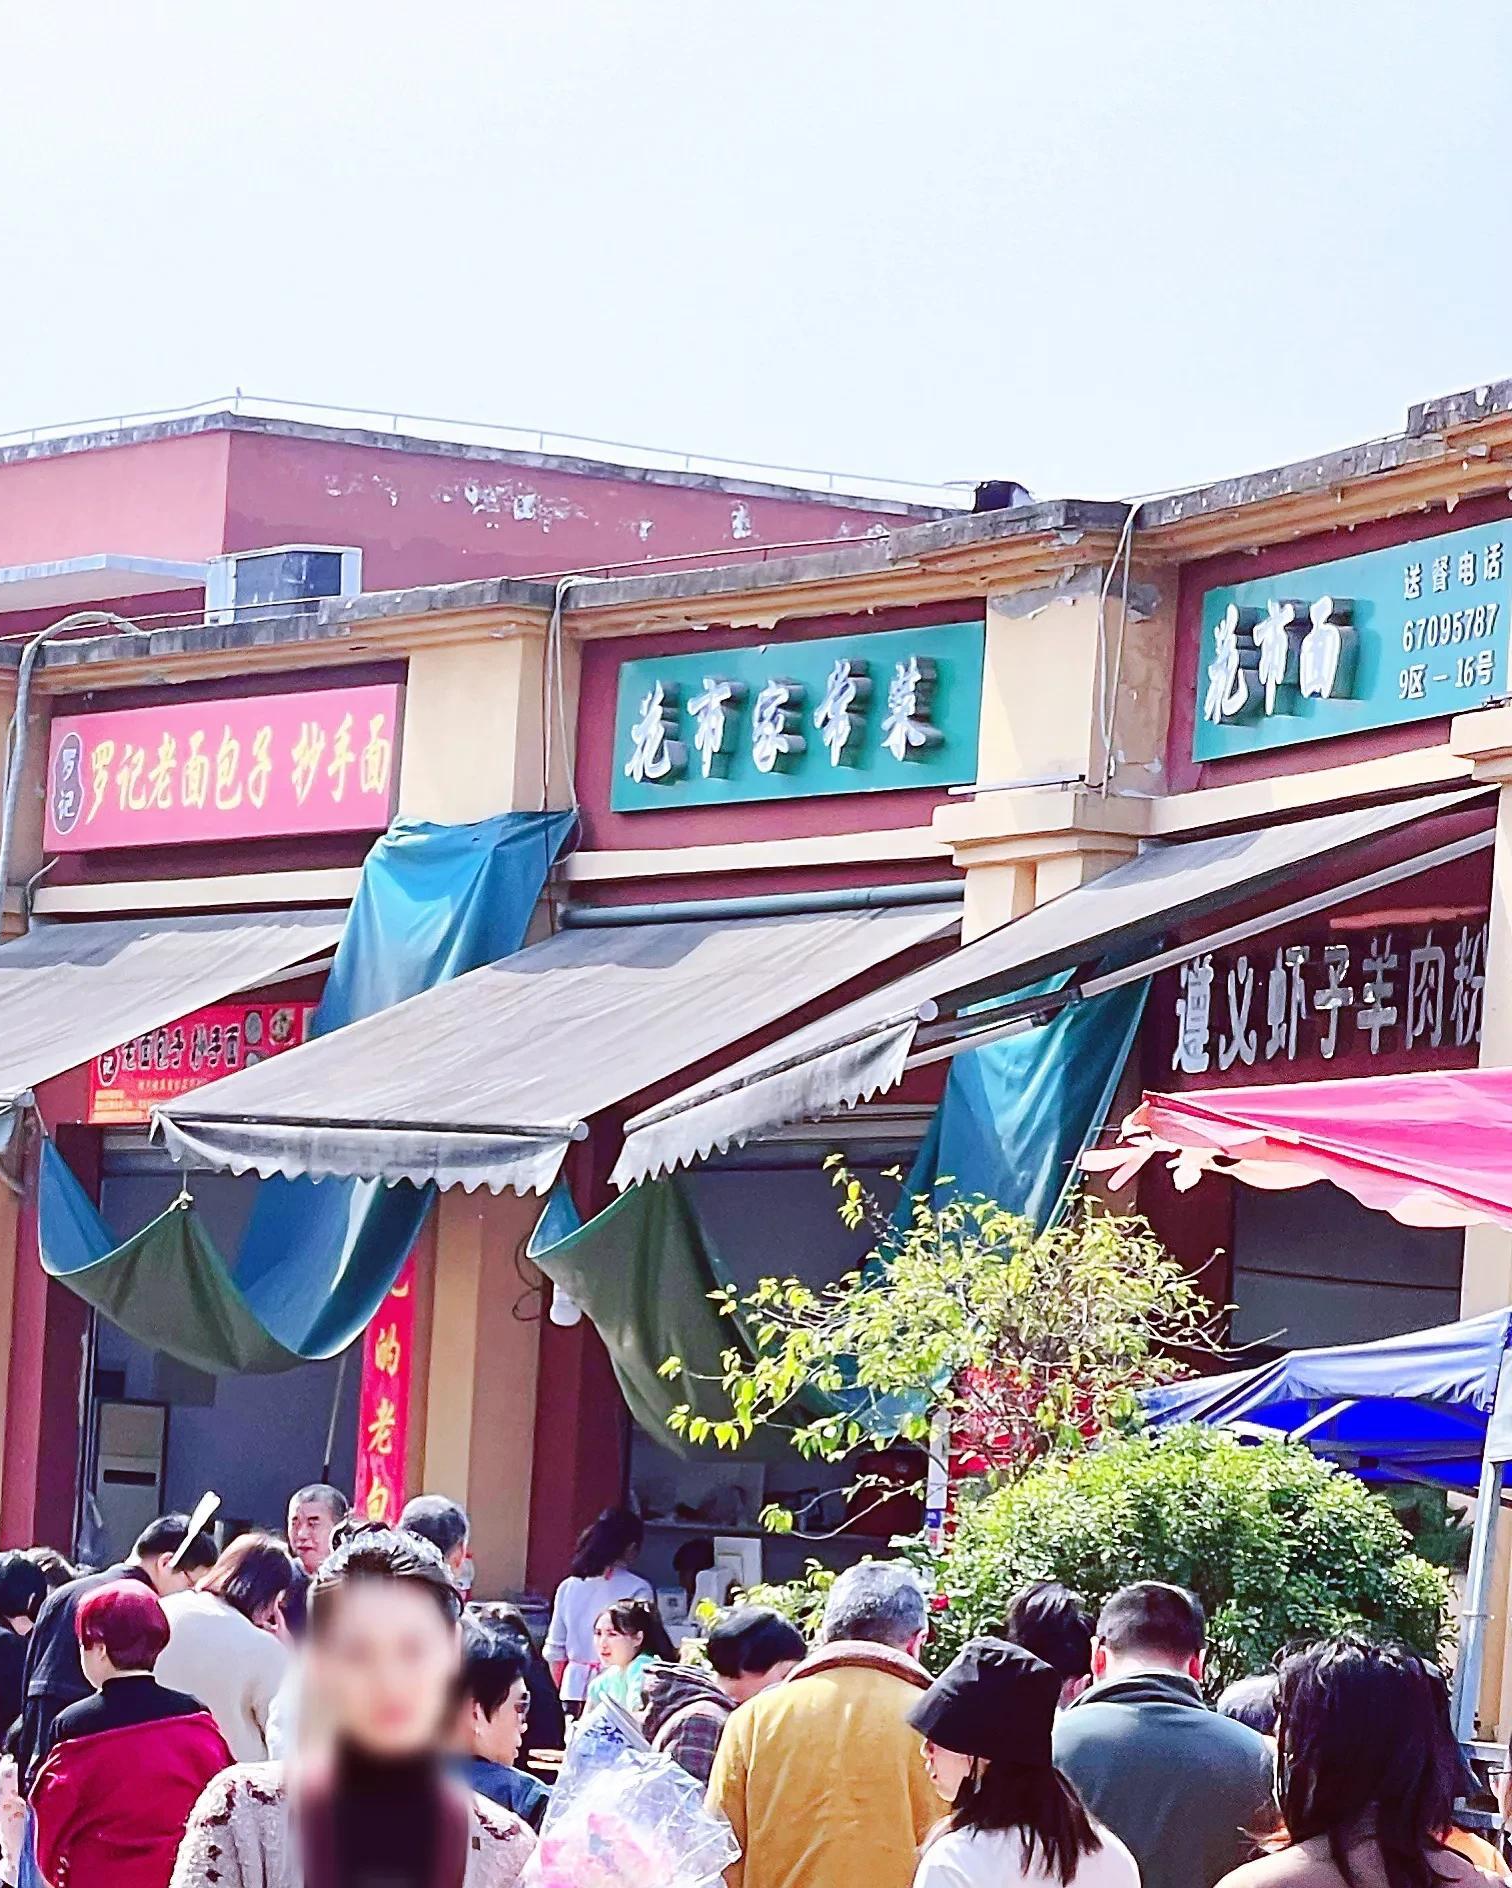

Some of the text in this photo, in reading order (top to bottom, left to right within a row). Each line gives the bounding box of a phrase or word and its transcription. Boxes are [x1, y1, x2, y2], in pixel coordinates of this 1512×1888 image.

[1204, 595, 1341, 724] 花市面
[1402, 603, 1500, 652] 67095787
[86, 712, 392, 825] 罗记老面包子 抄手面
[624, 655, 926, 784] 花市家常菜
[1172, 923, 1487, 1074] 遵义虾子羊肉粉
